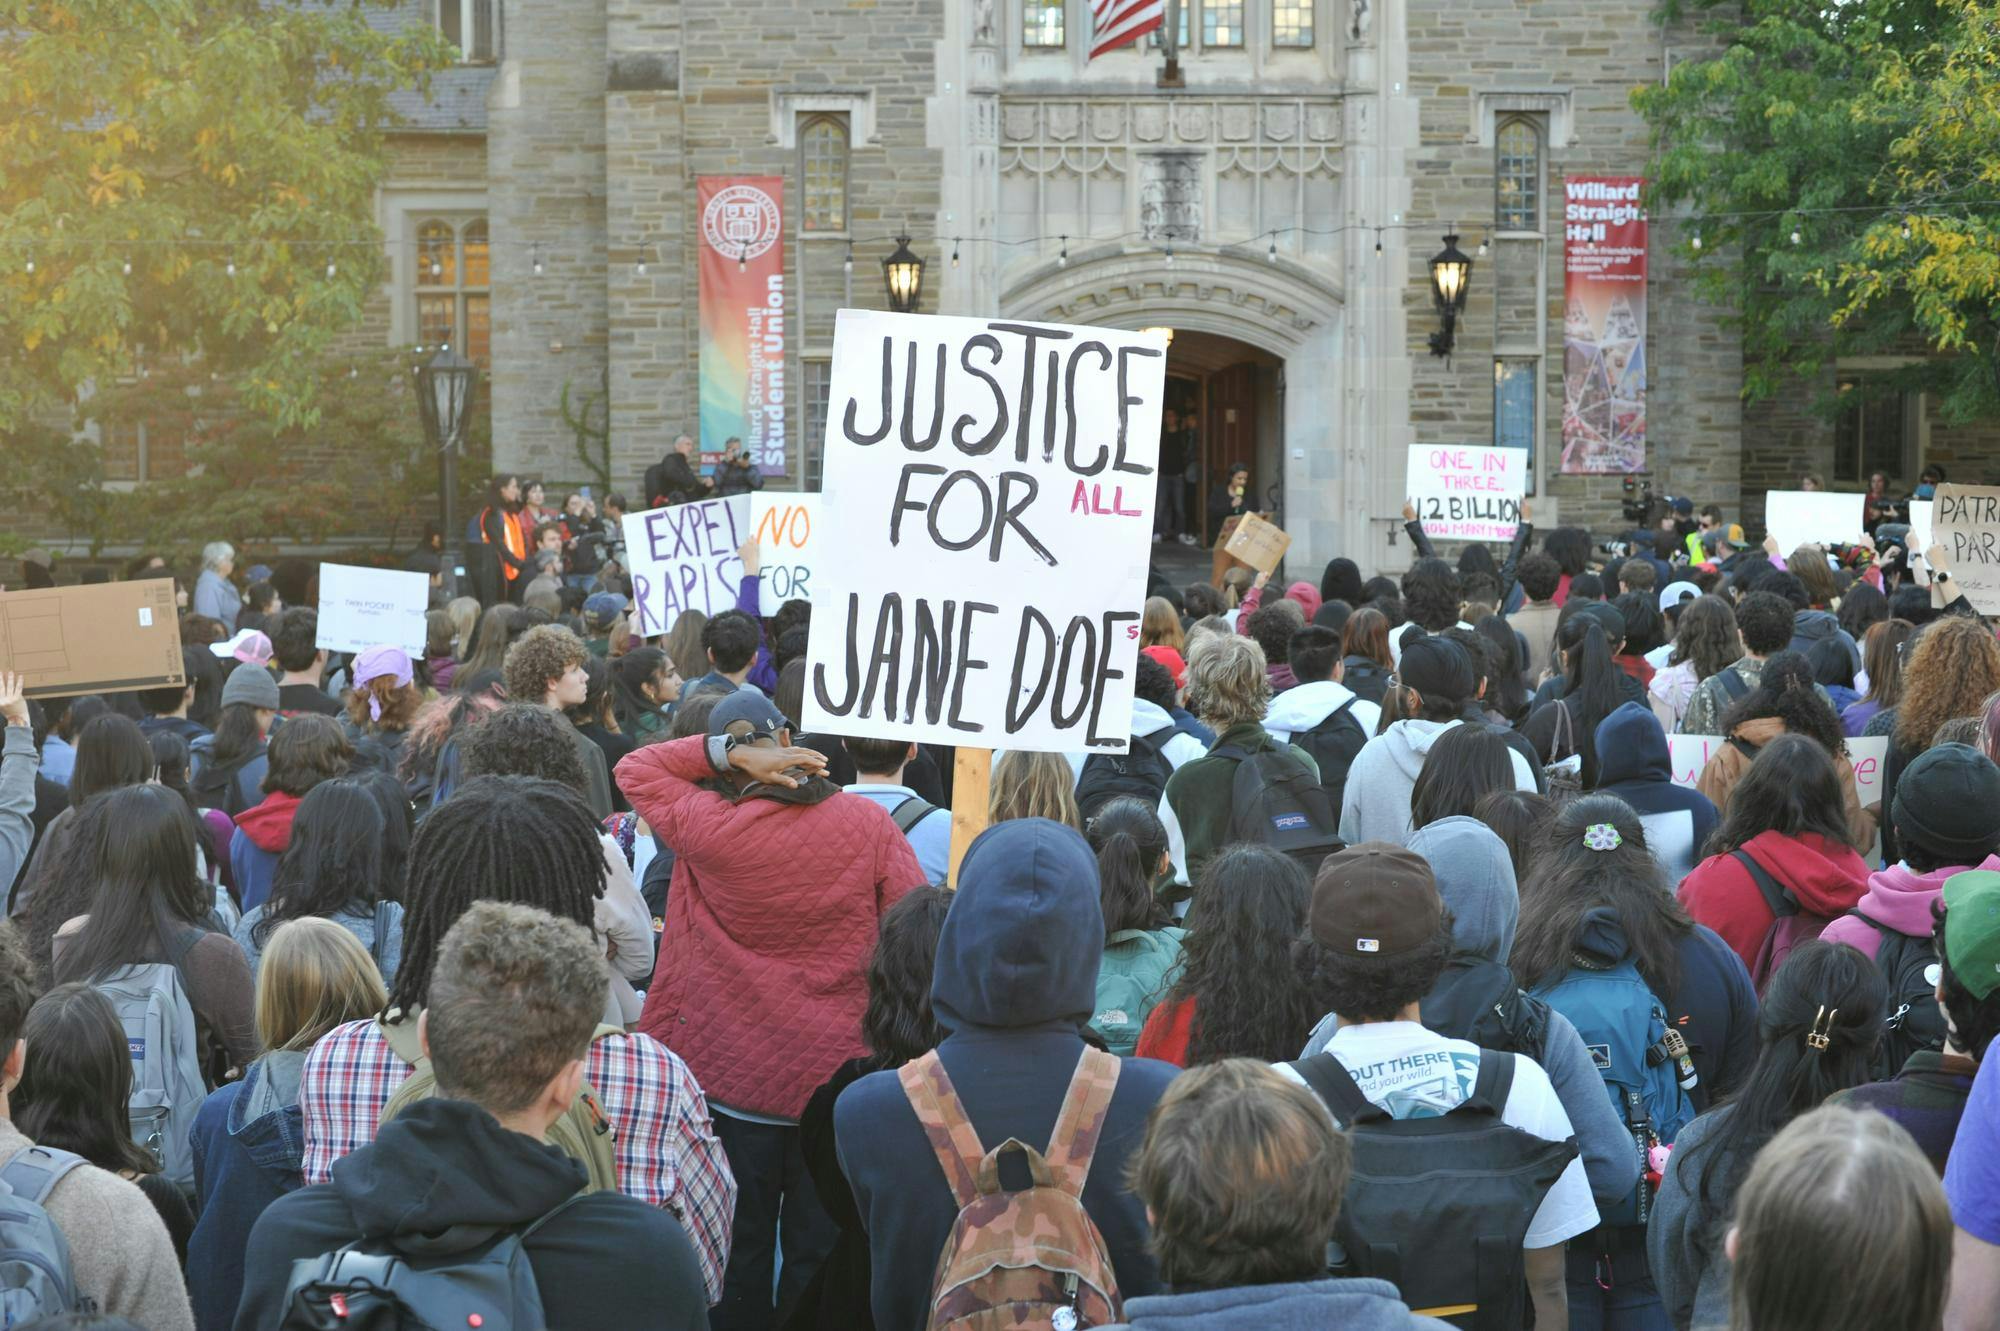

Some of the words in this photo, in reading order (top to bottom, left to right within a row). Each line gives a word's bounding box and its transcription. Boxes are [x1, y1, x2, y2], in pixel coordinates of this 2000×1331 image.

[1566, 182, 1639, 200] Willard
[1566, 223, 1606, 241] Hall
[747, 307, 762, 338] Hall
[762, 274, 784, 353] Union
[748, 342, 766, 406] Straight
[763, 359, 785, 466] Student
[842, 323, 1162, 477] JUSTICE
[748, 408, 762, 465] Willard
[1431, 450, 1473, 470] ONE
[1483, 452, 1506, 472] IN
[890, 463, 1057, 567] FOR
[1071, 479, 1143, 516] ALL
[1449, 496, 1521, 523] BILLION
[1940, 495, 2000, 524] PATR
[645, 500, 740, 562] EXPEL
[757, 505, 811, 549] NO
[1954, 531, 2000, 565] PAR
[759, 564, 811, 599] FOR
[813, 592, 999, 732] JANE
[1361, 1080, 1377, 1092] nd
[1379, 1075, 1404, 1090] your
[1406, 1066, 1435, 1081] wild.
[1388, 1051, 1449, 1073] THERE
